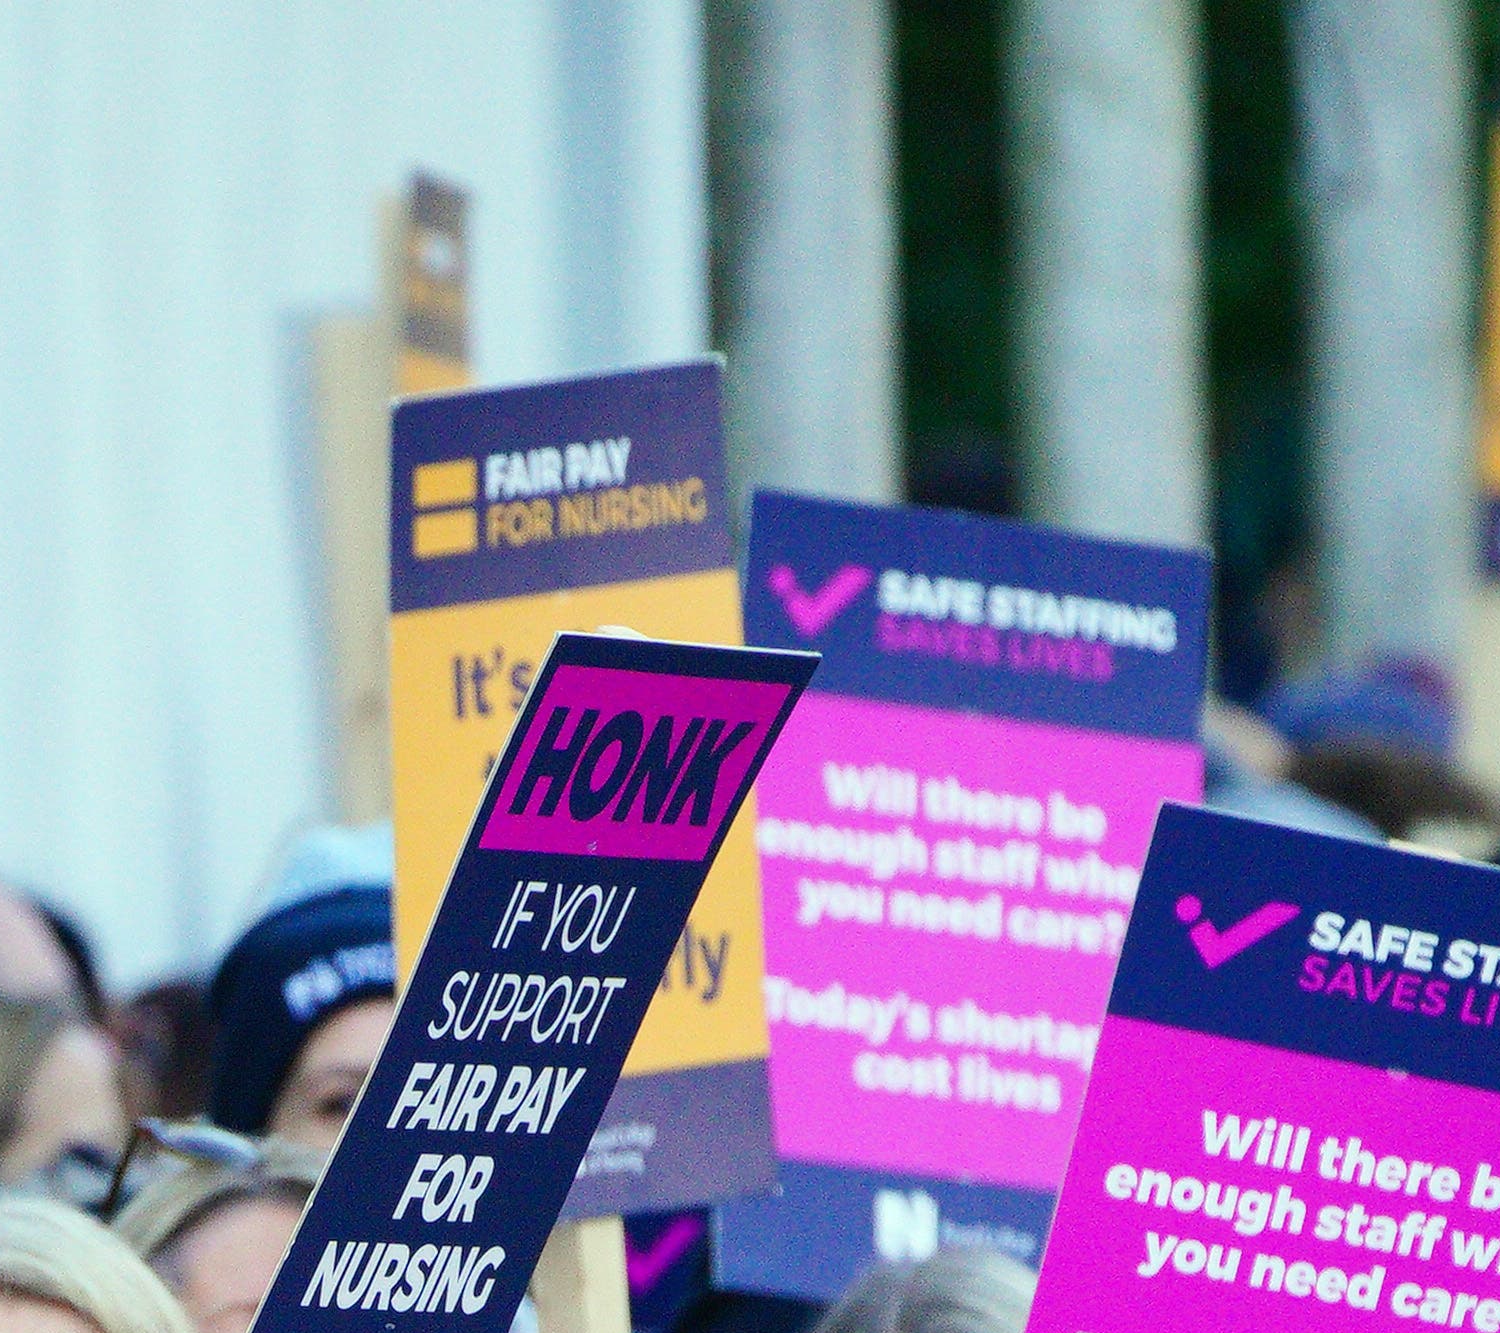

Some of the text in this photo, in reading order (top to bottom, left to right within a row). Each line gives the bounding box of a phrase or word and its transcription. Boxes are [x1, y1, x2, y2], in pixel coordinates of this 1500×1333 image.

[485, 437, 631, 499] FAIR PAY
[486, 477, 707, 546] FOR NURSING
[878, 571, 1176, 652] SAFE STAFFING
[508, 706, 757, 827] HONK
[824, 763, 1107, 843] Will there be
[756, 817, 1042, 887] enough staff
[492, 881, 637, 954] IF YOU
[798, 878, 885, 926] you
[889, 890, 1003, 939] need
[1309, 912, 1439, 972] SAFE
[427, 971, 627, 1044] SUPPORT
[1299, 954, 1450, 1016] SAVES
[386, 1062, 587, 1134] FAIR PAY
[853, 1052, 1061, 1113] cost lives
[392, 1153, 494, 1223] FOR
[1202, 1110, 1311, 1173] Will
[1318, 1136, 1461, 1202] there
[1104, 1163, 1306, 1236] enough
[1314, 1203, 1447, 1260] staff
[300, 1240, 506, 1315] NURSING
[1136, 1231, 1242, 1283] you
[1249, 1253, 1386, 1311] need
